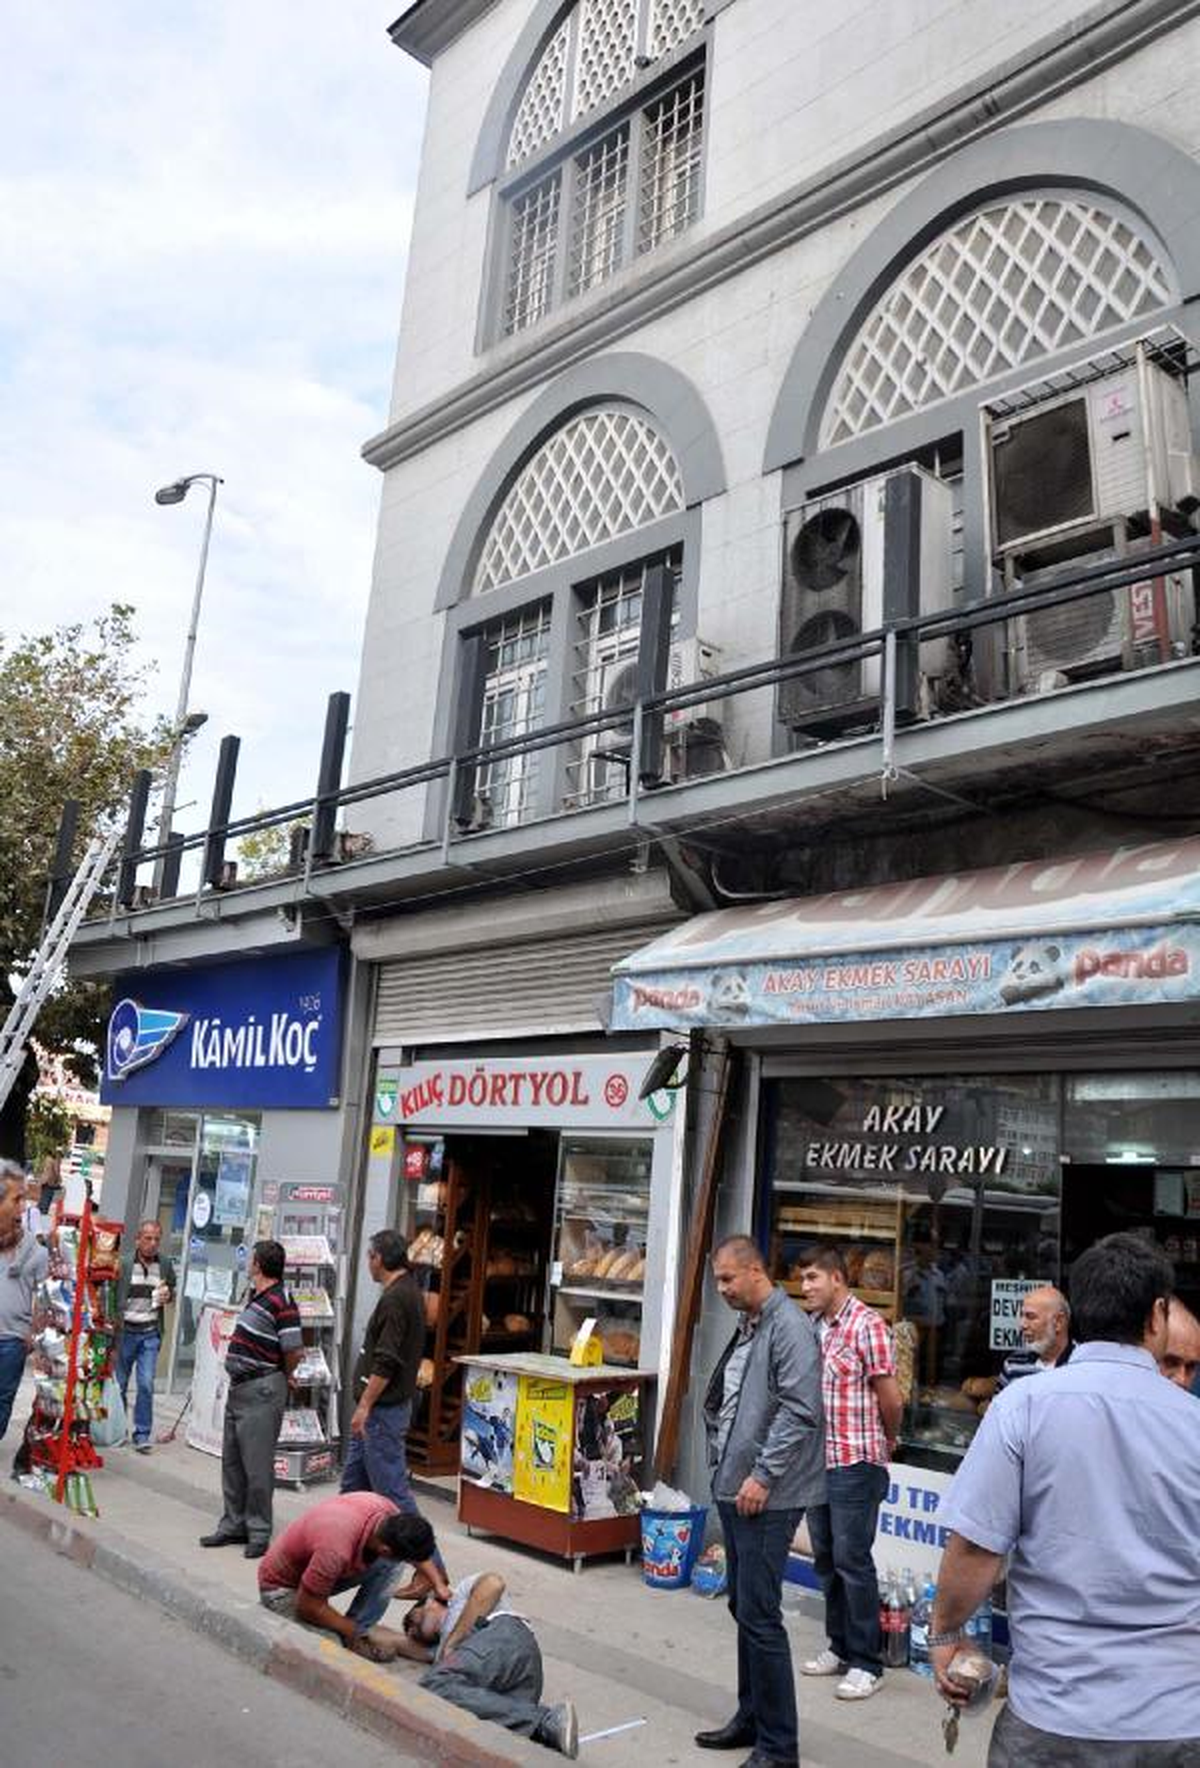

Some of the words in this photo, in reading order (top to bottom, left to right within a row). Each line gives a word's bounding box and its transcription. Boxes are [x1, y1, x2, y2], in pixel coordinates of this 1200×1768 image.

[1130, 580, 1155, 641] VEST
[763, 969, 818, 993] AKAY
[824, 963, 896, 990] EKMEK
[902, 954, 991, 984] SARAYI
[268, 1013, 320, 1073] KOÇ
[400, 1072, 444, 1119] KILIÇ
[448, 1066, 590, 1107] DÖRTYOL
[863, 1105, 943, 1134] AKAY
[806, 1143, 898, 1172] EKMEK
[905, 1146, 1008, 1174] SARAYI
[994, 1328, 1024, 1347] EKM
[906, 1487, 941, 1513] TR
[880, 1512, 955, 1549] EKME
